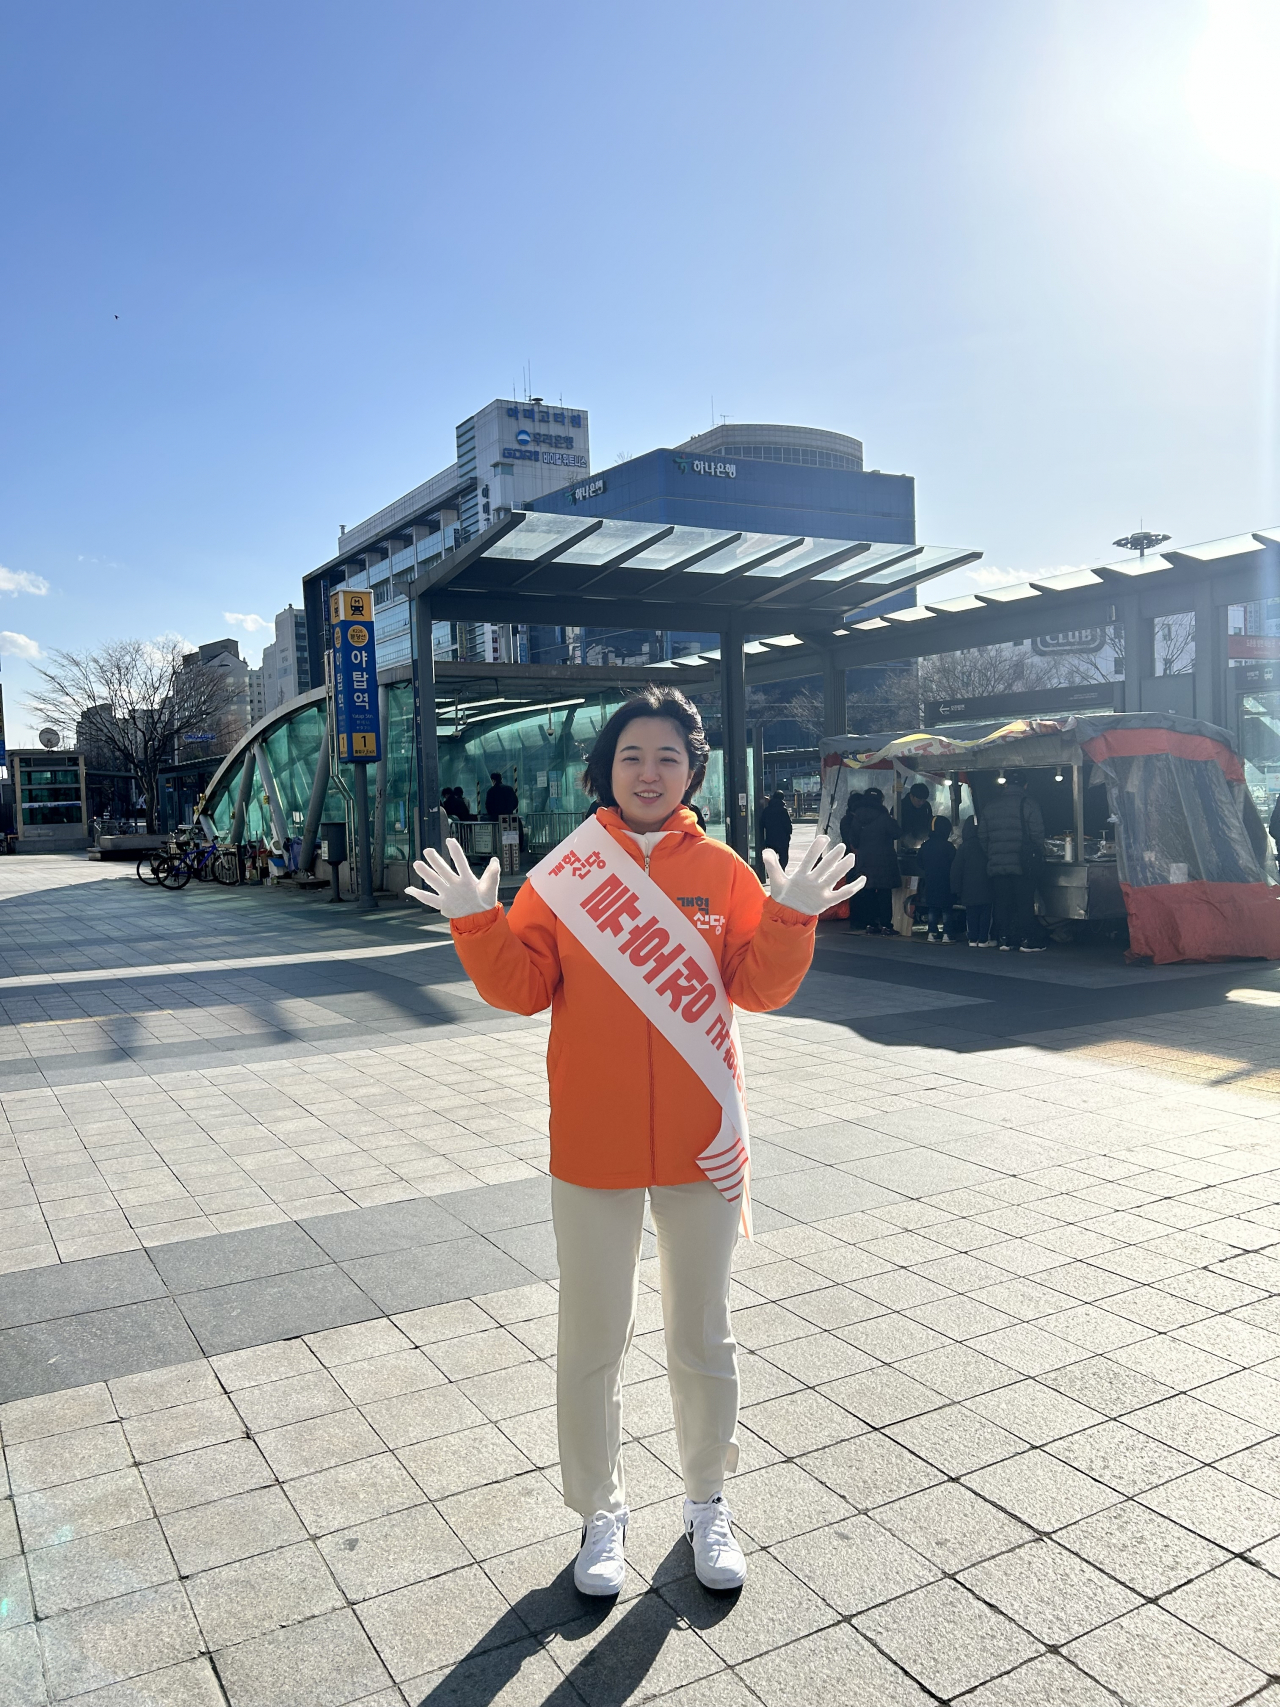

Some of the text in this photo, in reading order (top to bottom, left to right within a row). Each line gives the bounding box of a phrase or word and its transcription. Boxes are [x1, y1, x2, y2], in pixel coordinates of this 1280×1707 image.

[507, 406, 582, 428] 아미고타워
[533, 432, 574, 449] 우리은행
[693, 459, 736, 478] 하나은행
[575, 479, 604, 501] 하나은행
[351, 650, 370, 711] 야탑역
[361, 735, 367, 748] 1
[548, 850, 582, 877] 개혁
[572, 850, 607, 880] 신당
[677, 896, 710, 915] 개혁
[693, 913, 726, 936] 신당
[580, 873, 718, 1024] 류호정
